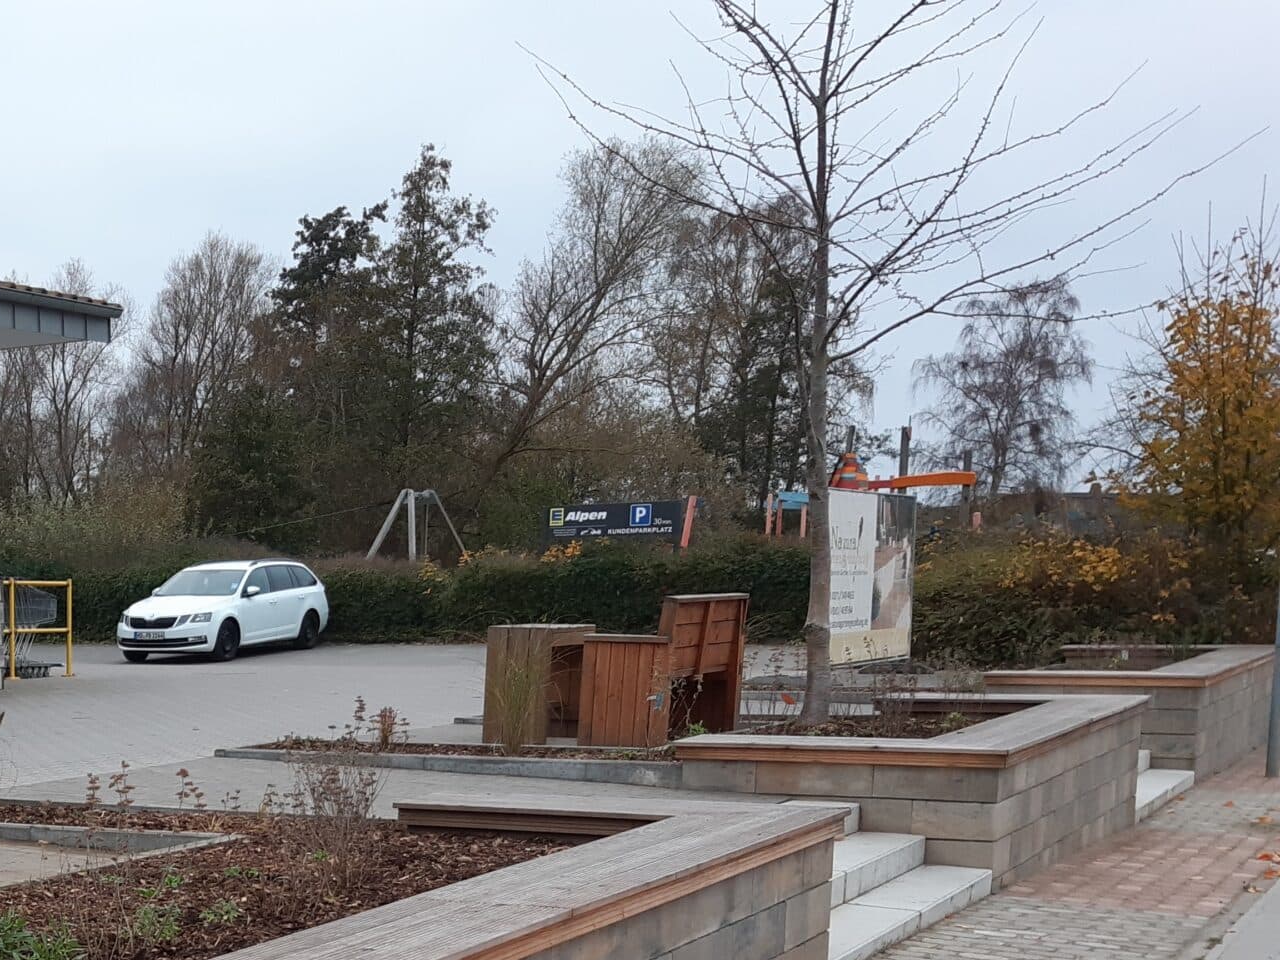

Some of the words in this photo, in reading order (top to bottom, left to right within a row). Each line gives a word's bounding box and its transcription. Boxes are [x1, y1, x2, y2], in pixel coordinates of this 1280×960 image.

[565, 510, 608, 522] Alpen
[635, 507, 647, 523] P
[607, 526, 673, 535] KUNDENPARKPLATZ
